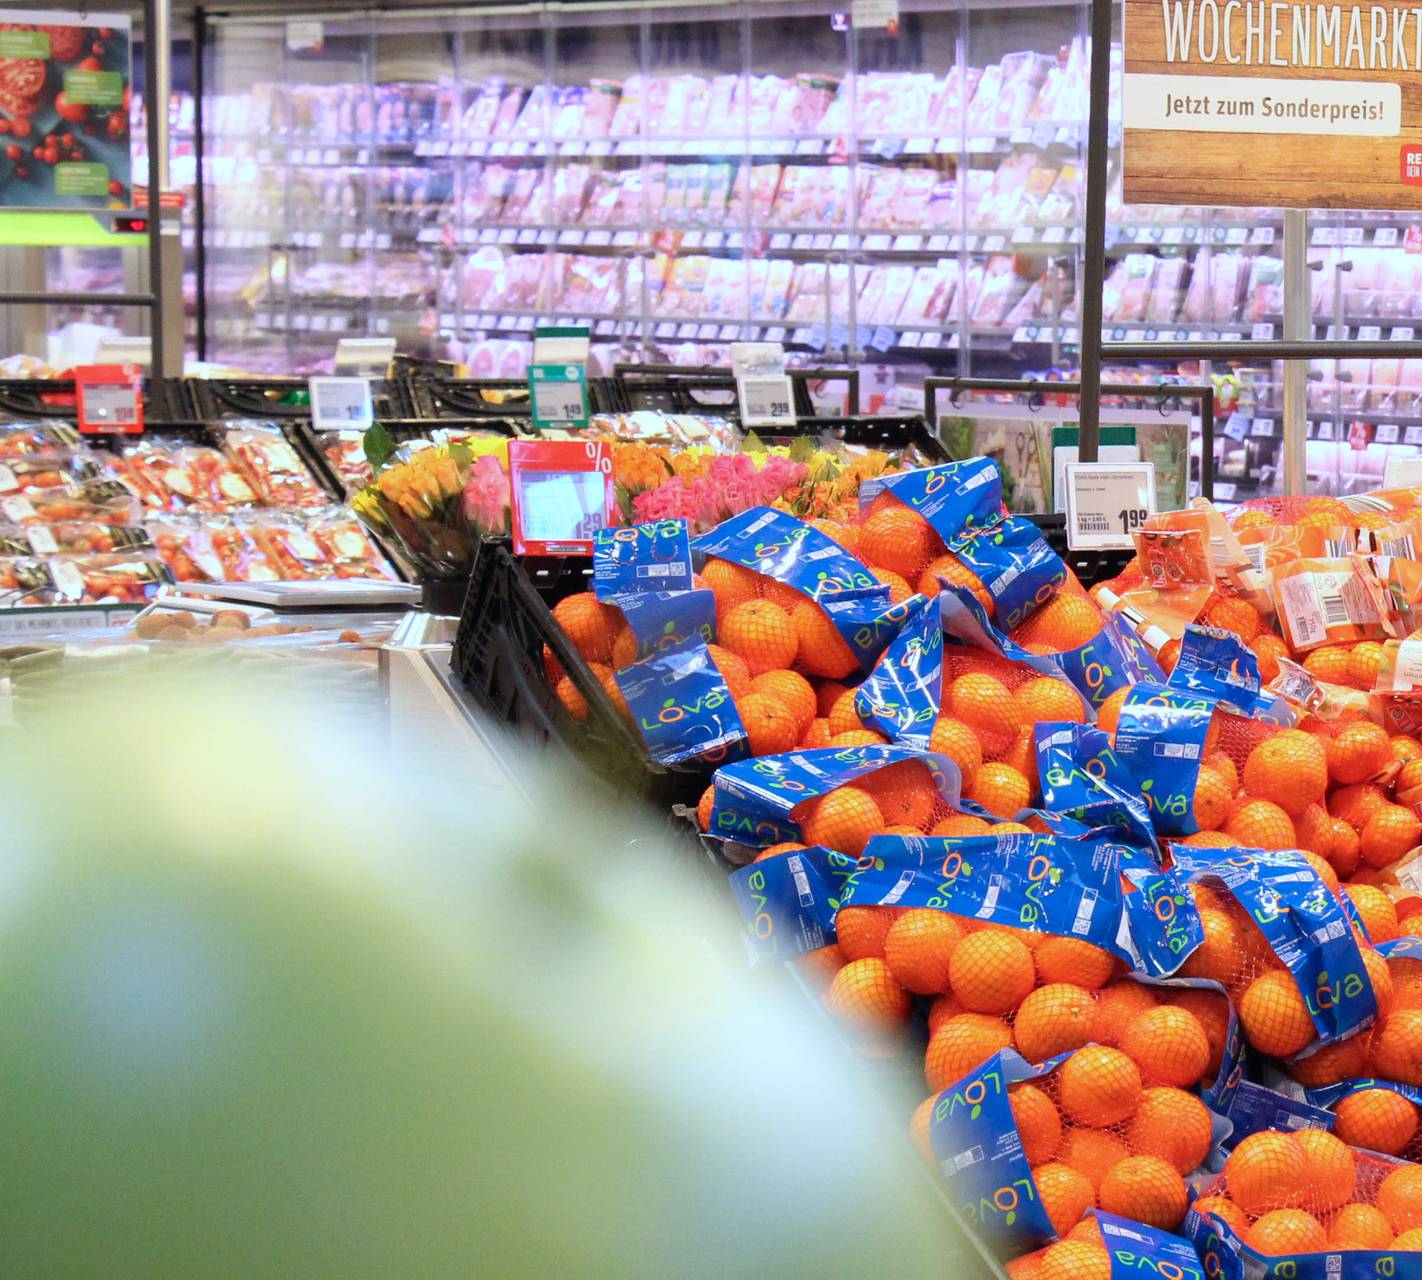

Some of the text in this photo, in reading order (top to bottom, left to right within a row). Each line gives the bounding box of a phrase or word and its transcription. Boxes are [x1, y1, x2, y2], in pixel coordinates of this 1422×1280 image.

[1166, 93, 1384, 123] Jetzt zum Sonderpreis!
[1406, 165, 1420, 177] DEIN
